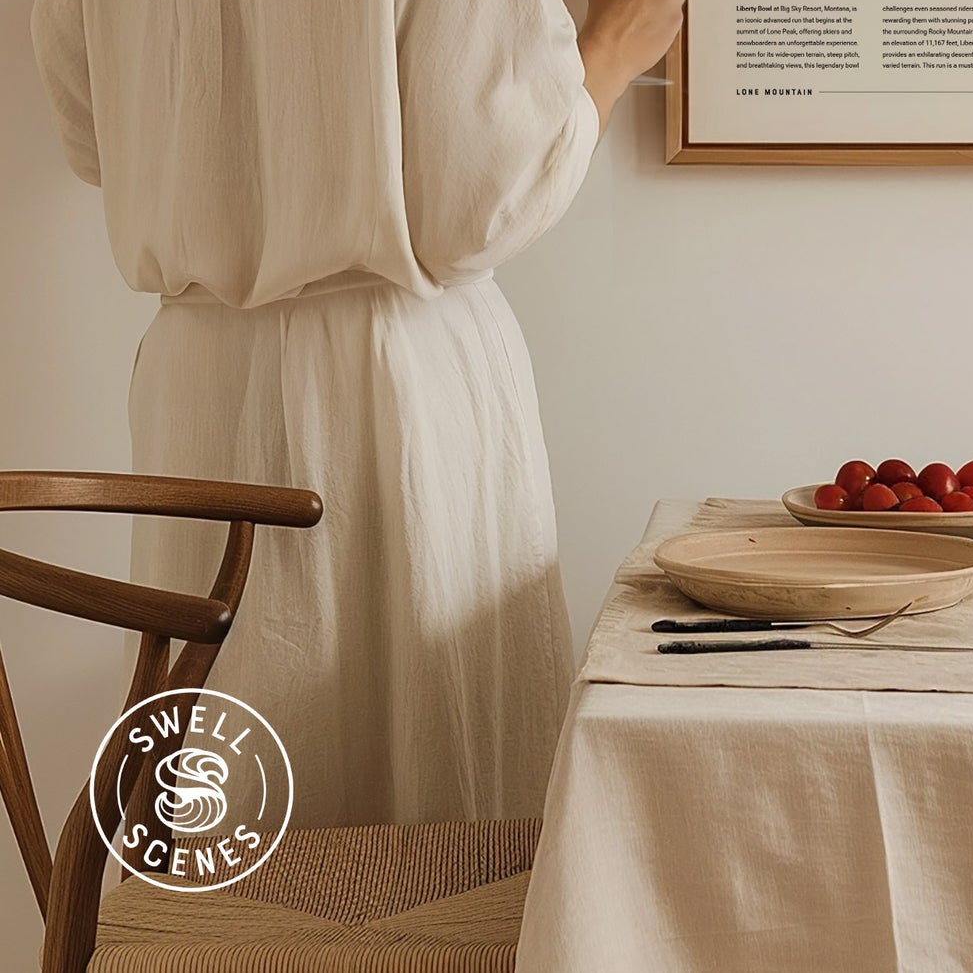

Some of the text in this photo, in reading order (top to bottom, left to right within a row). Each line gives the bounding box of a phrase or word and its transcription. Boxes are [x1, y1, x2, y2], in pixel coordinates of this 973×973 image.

[736, 5, 757, 13] Liberty
[780, 5, 790, 13] Big
[791, 5, 802, 13] Sky
[882, 5, 914, 13] challenges
[815, 16, 835, 25] begins
[882, 16, 911, 25] rewarding
[941, 16, 967, 25] stunning
[798, 28, 822, 36] offering
[893, 28, 928, 36] surrounding
[928, 28, 946, 36] Rocky
[786, 39, 825, 48] unforgettable
[926, 39, 945, 48] 11,167
[775, 51, 805, 59] wide-open
[826, 51, 843, 59] steep
[882, 51, 907, 59] provides
[916, 51, 950, 59] exhilarating
[748, 62, 785, 70] breathtaking
[816, 62, 844, 70] legendary
